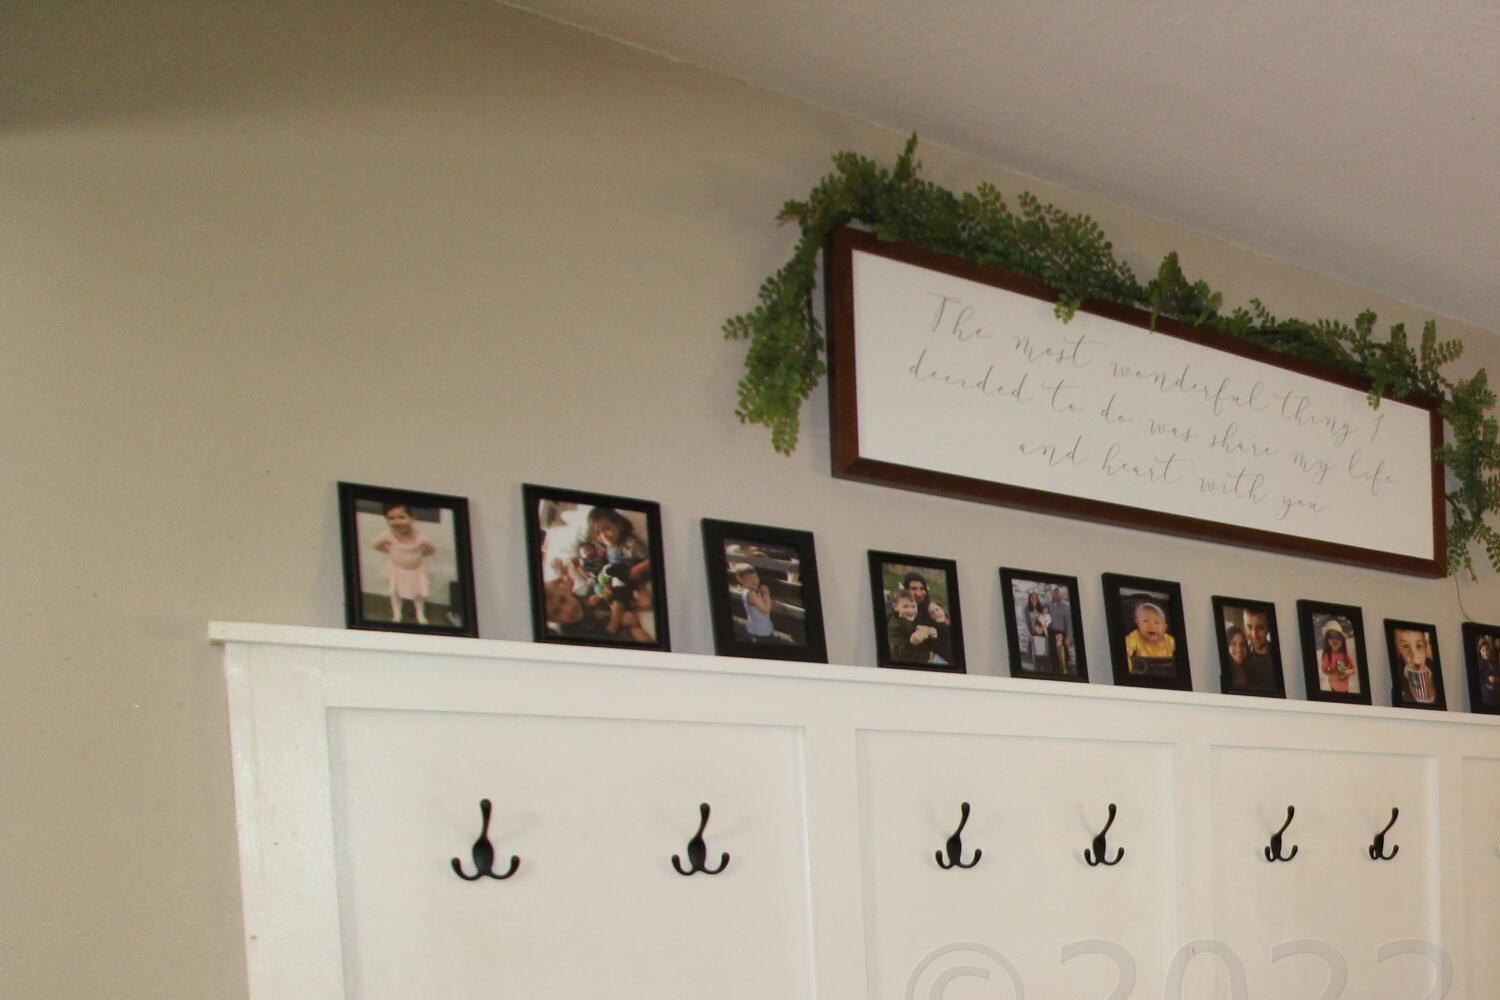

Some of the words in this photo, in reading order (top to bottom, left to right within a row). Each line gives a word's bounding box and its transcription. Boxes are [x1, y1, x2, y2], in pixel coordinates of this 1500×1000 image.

[908, 348, 1034, 404] decided
[1041, 379, 1086, 412] to
[1100, 394, 1134, 424] do
[1148, 417, 1199, 442] was
[1209, 422, 1278, 456] share
[1290, 451, 1336, 485] my
[1347, 449, 1396, 496] life
[925, 291, 991, 341] The
[1012, 334, 1104, 367] most
[1110, 361, 1269, 416] wonderful
[1274, 390, 1356, 447] thing
[1370, 413, 1385, 442] I
[1017, 435, 1088, 466] and
[1101, 442, 1192, 484] heart
[1198, 467, 1268, 504] with
[1274, 496, 1325, 521] you
